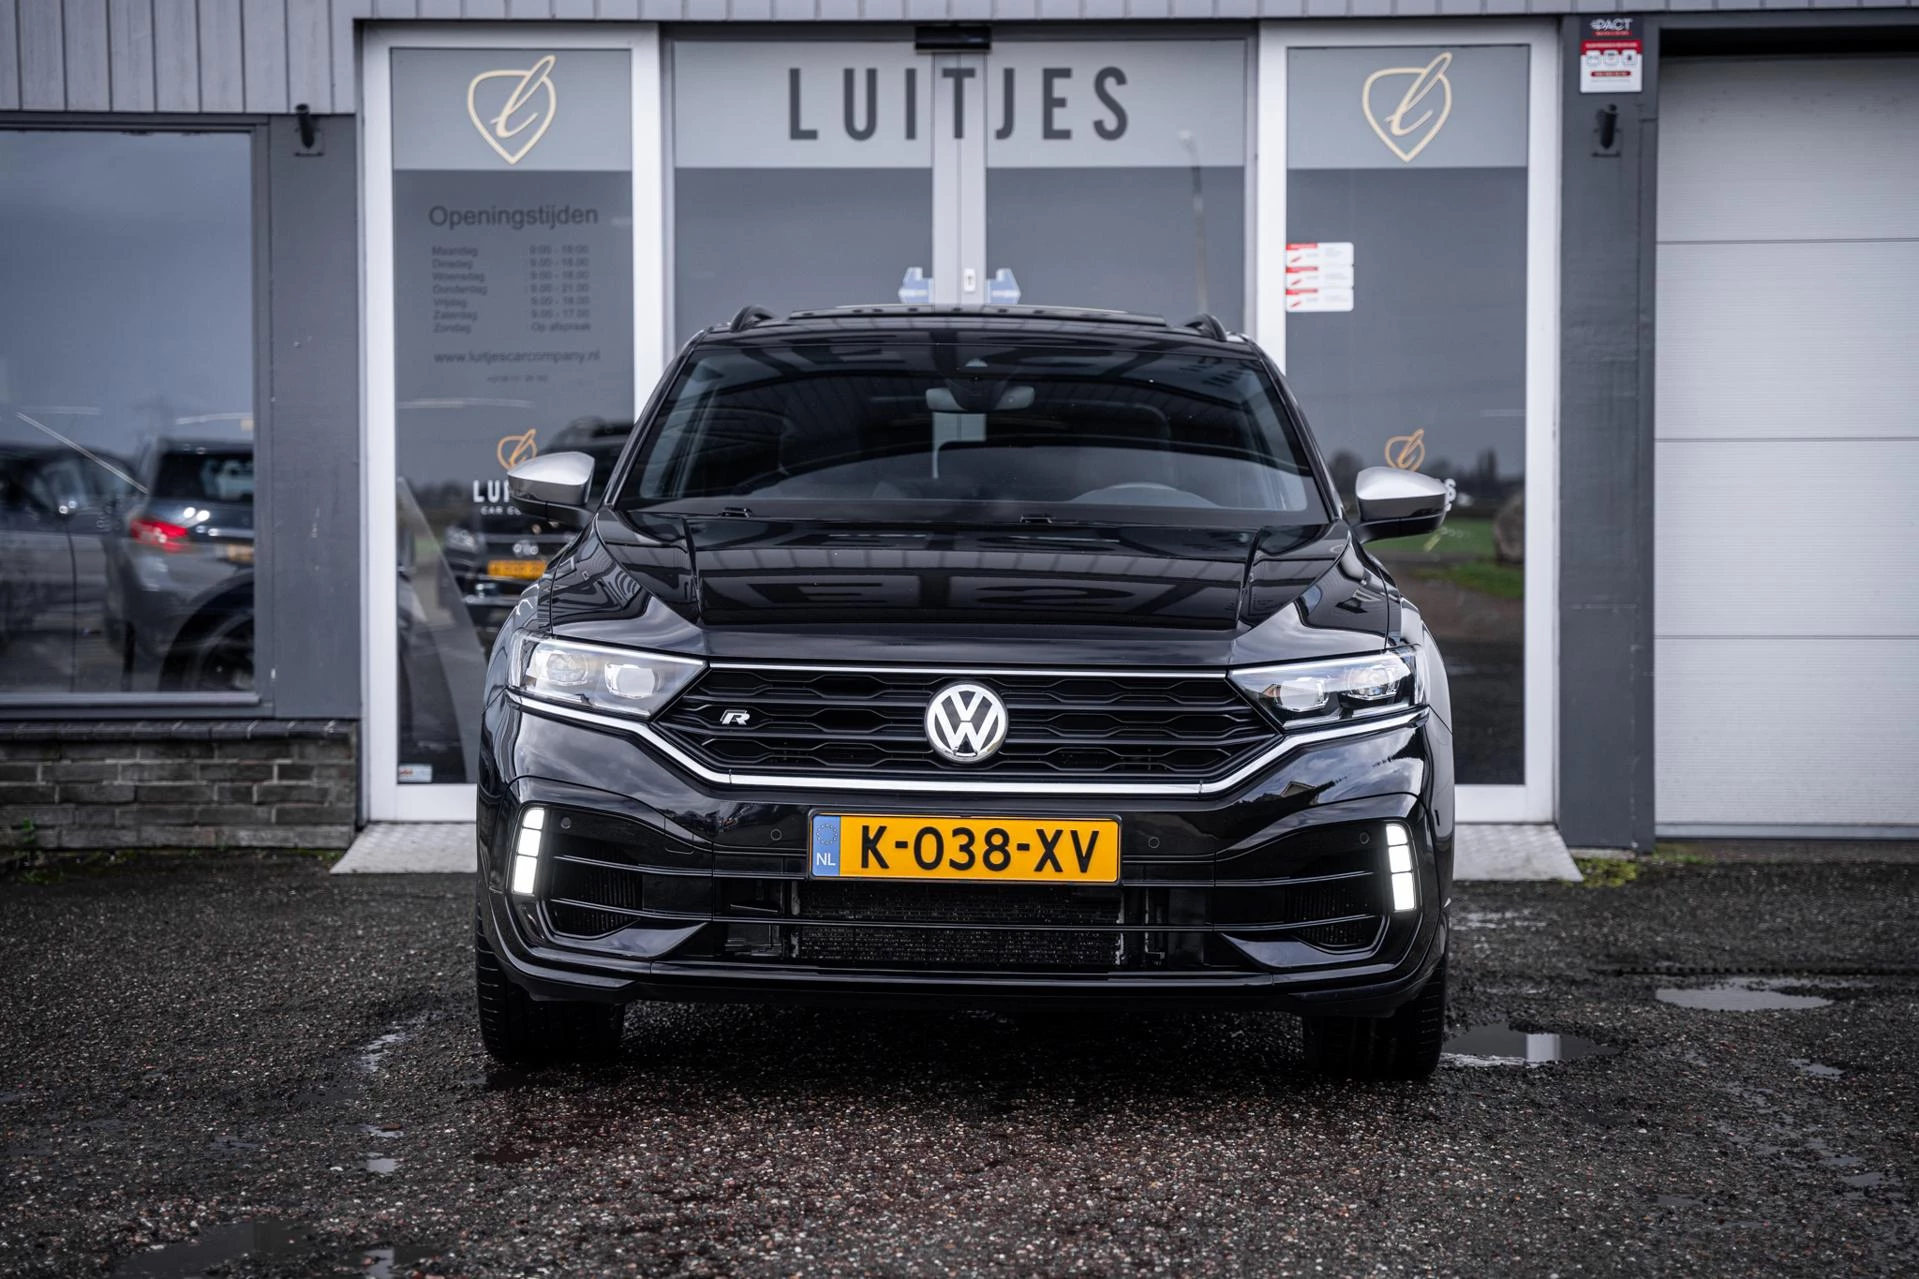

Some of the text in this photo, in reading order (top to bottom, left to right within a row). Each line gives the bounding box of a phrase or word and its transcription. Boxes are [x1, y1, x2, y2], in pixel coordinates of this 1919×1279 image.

[788, 66, 1128, 141] LUITJES
[428, 205, 599, 230] Openingstijden
[720, 710, 750, 725] R
[816, 825, 1100, 873] NL K-038-XV
